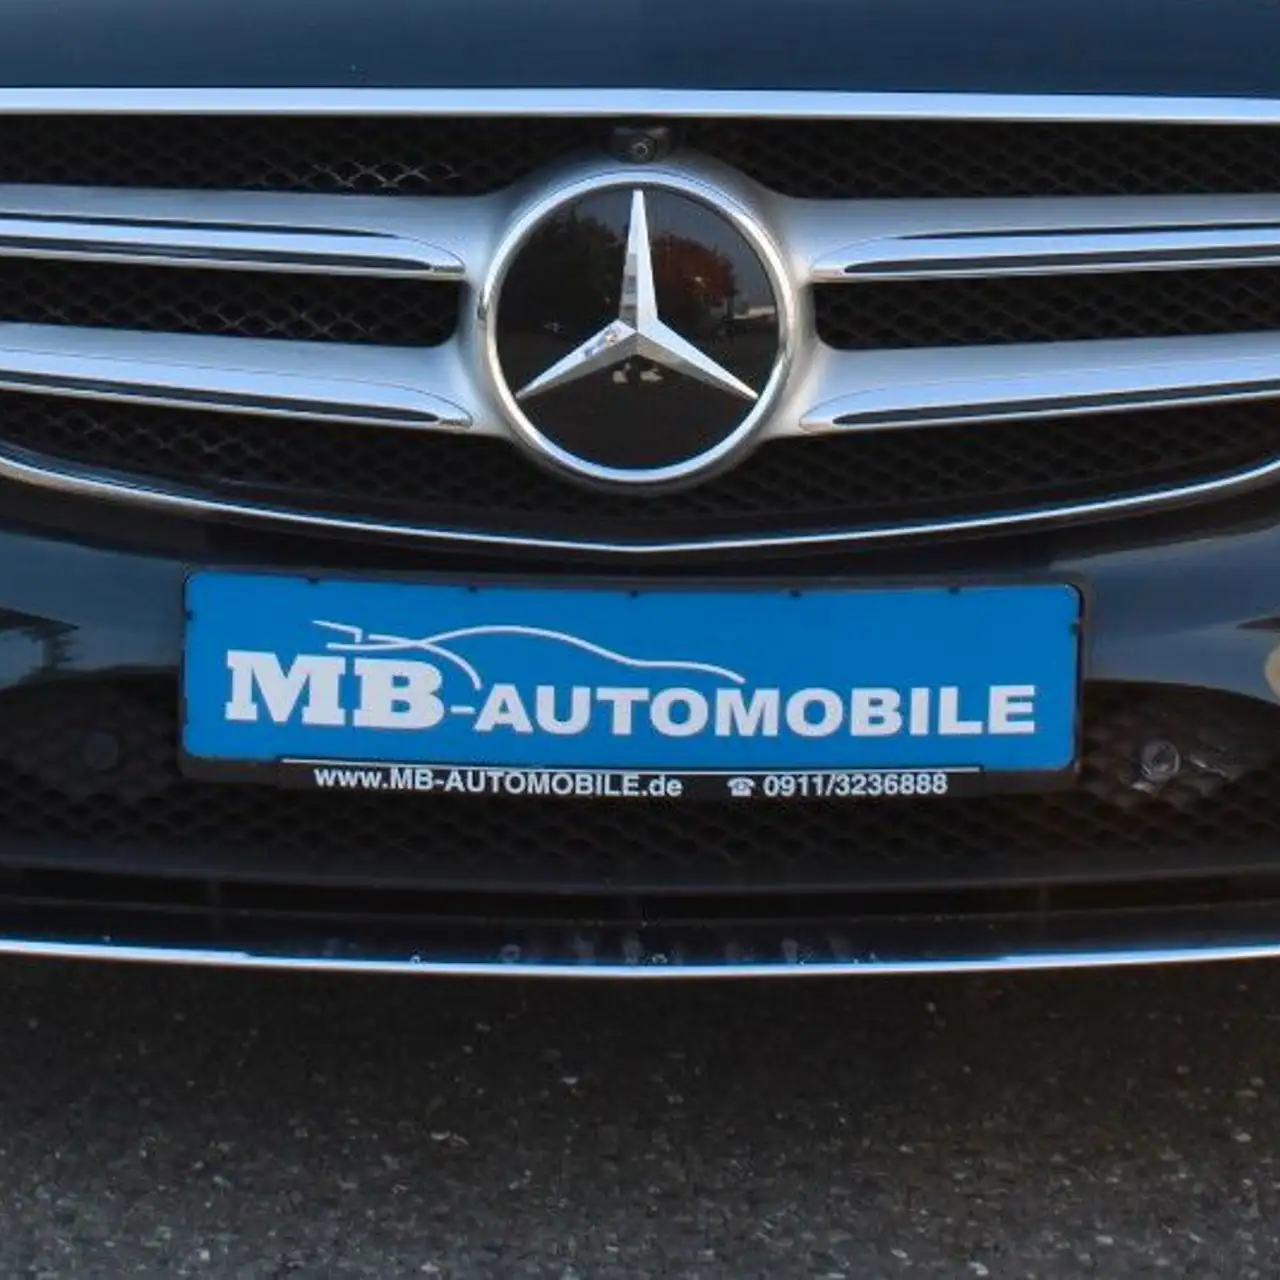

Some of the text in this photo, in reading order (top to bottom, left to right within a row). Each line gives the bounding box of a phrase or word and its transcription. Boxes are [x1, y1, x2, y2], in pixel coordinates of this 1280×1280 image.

[226, 651, 1036, 736] MB-AUTOMOBILE
[314, 766, 948, 798] www.MB-AUTOMOBILE.de 0911/3236888
